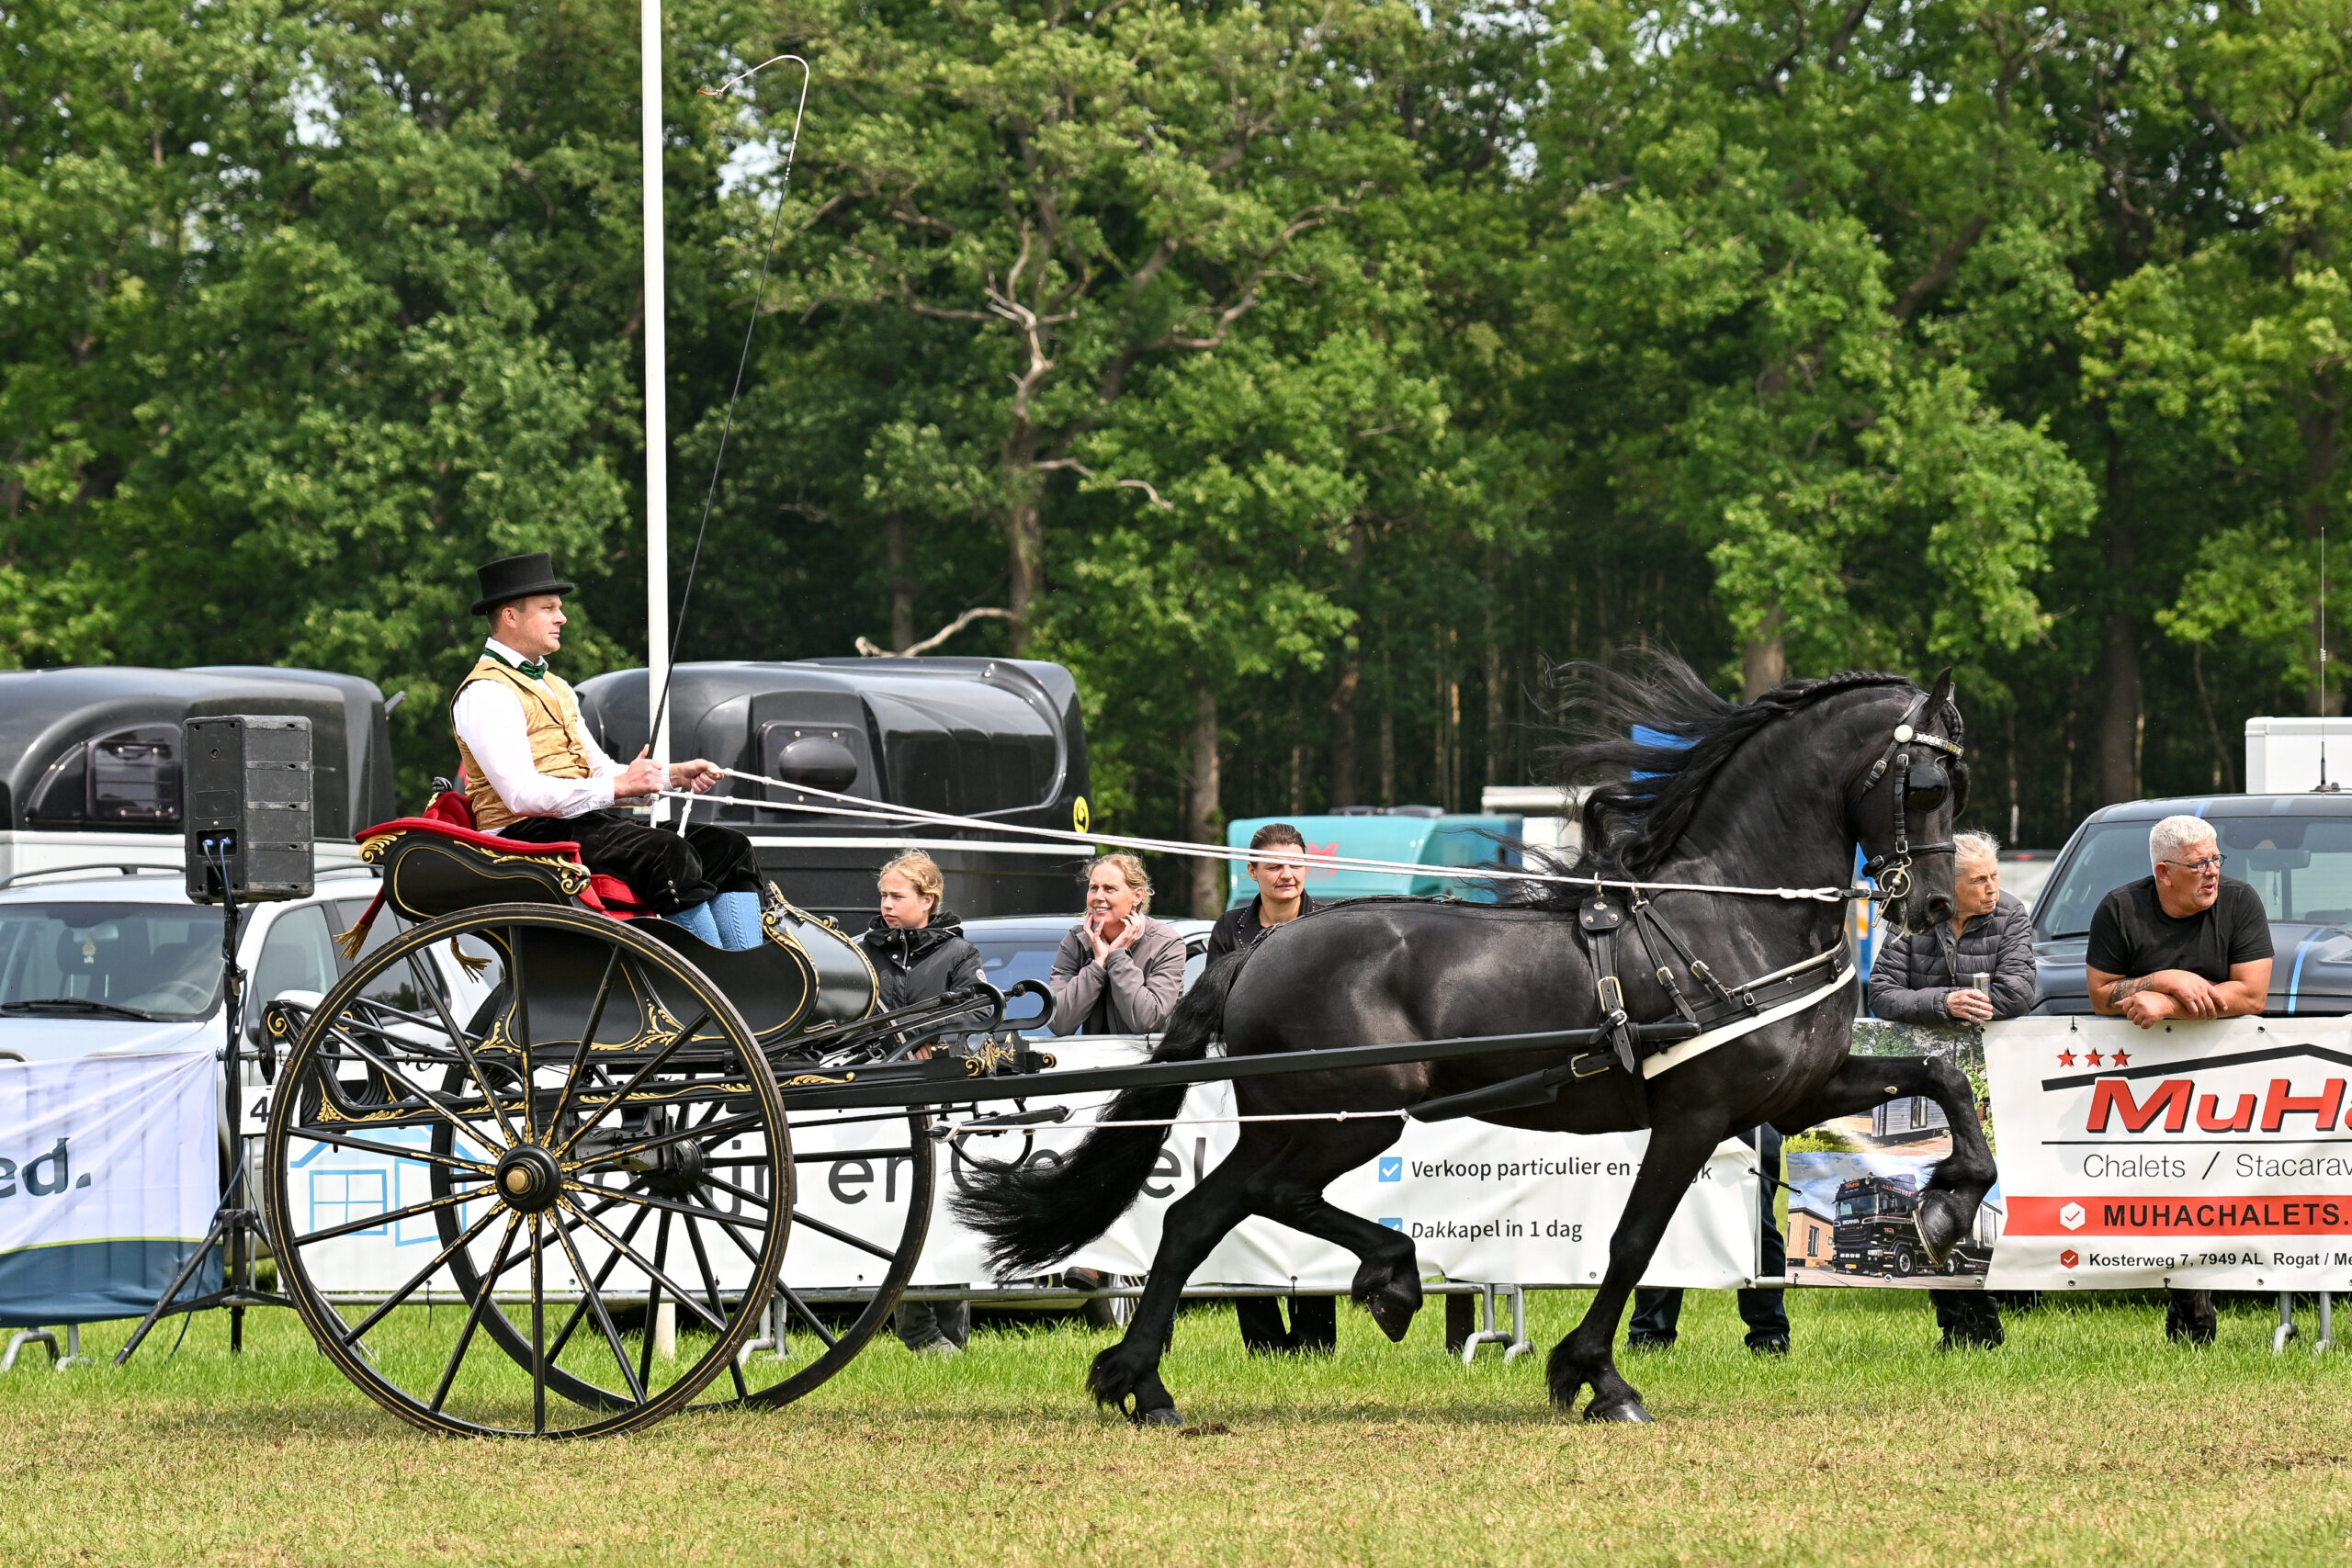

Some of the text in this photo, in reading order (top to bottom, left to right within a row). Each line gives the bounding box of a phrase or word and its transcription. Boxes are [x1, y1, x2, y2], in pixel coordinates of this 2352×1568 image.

[2086, 1078, 2352, 1133] MuH
[1411, 1159, 1493, 1181] Verkoop
[1498, 1156, 1601, 1181] particulier
[1606, 1162, 1630, 1176] en
[2083, 1154, 2187, 1178] Chalets
[2202, 1151, 2221, 1180] /
[2104, 1202, 2350, 1227] MUHACHALETS.
[1411, 1218, 1583, 1243] Dakkapel in 1 dag
[2089, 1252, 2177, 1269] Kosterweg
[2180, 1253, 2195, 1269] 7,
[2199, 1252, 2237, 1266] 7949
[2241, 1252, 2264, 1265] AL
[2273, 1252, 2320, 1269] Rogat
[2324, 1252, 2330, 1266] /
